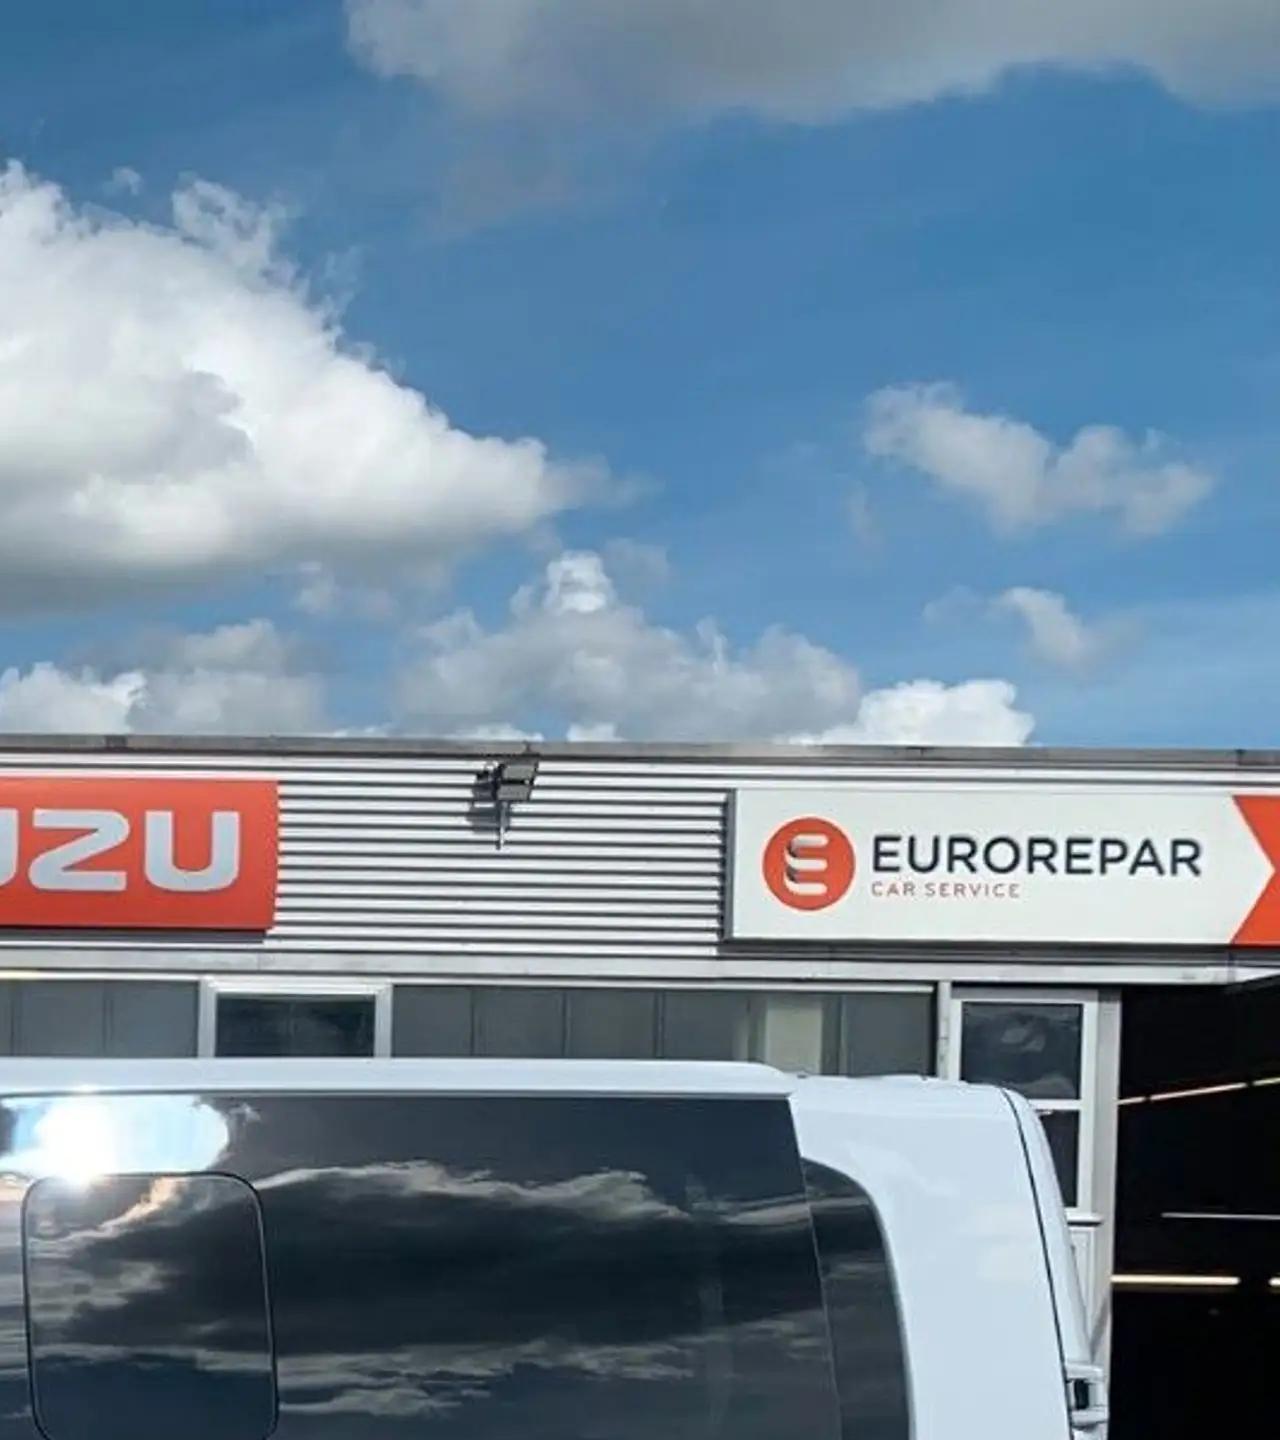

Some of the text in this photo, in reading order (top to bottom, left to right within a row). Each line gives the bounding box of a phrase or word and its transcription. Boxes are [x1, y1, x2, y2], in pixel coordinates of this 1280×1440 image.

[872, 835, 1202, 877] EUROREPAR
[871, 881, 1021, 898] CAR SERVICE
